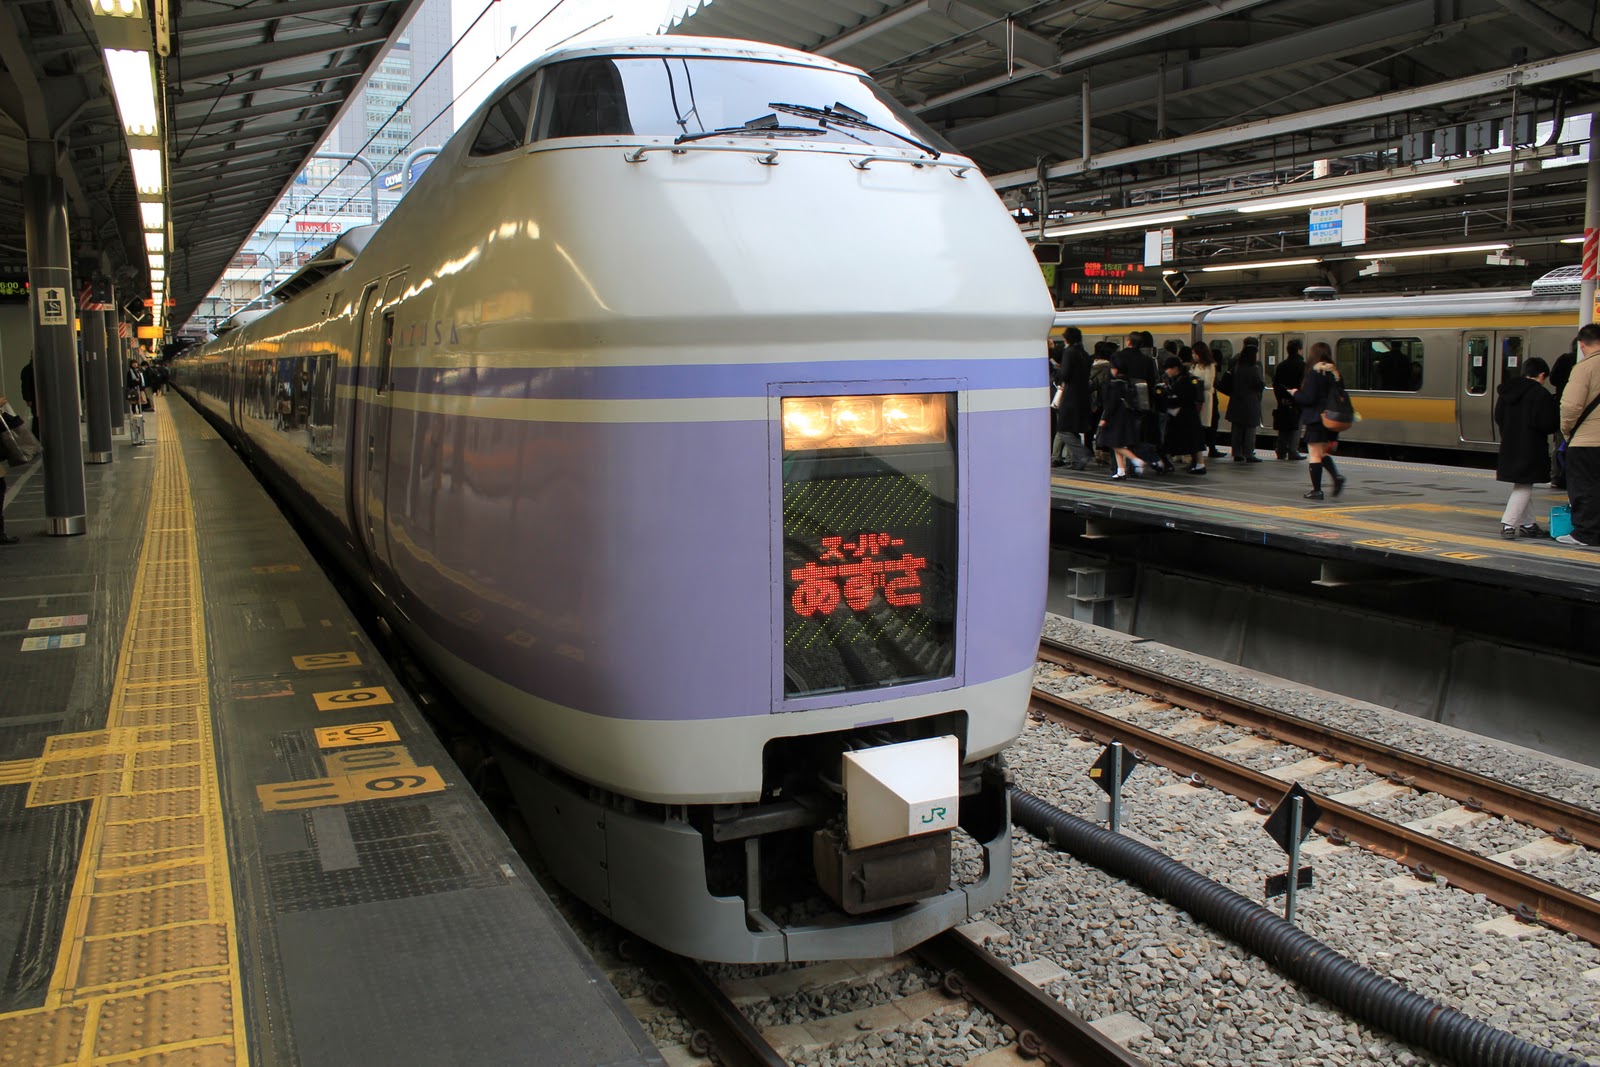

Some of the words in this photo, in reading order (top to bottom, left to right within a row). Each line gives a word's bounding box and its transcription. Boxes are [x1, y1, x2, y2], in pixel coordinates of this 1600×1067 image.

[385, 169, 412, 187] OLYMS
[820, 532, 905, 560] スーパー
[791, 553, 926, 617] あずさ
[921, 806, 947, 824] JR
